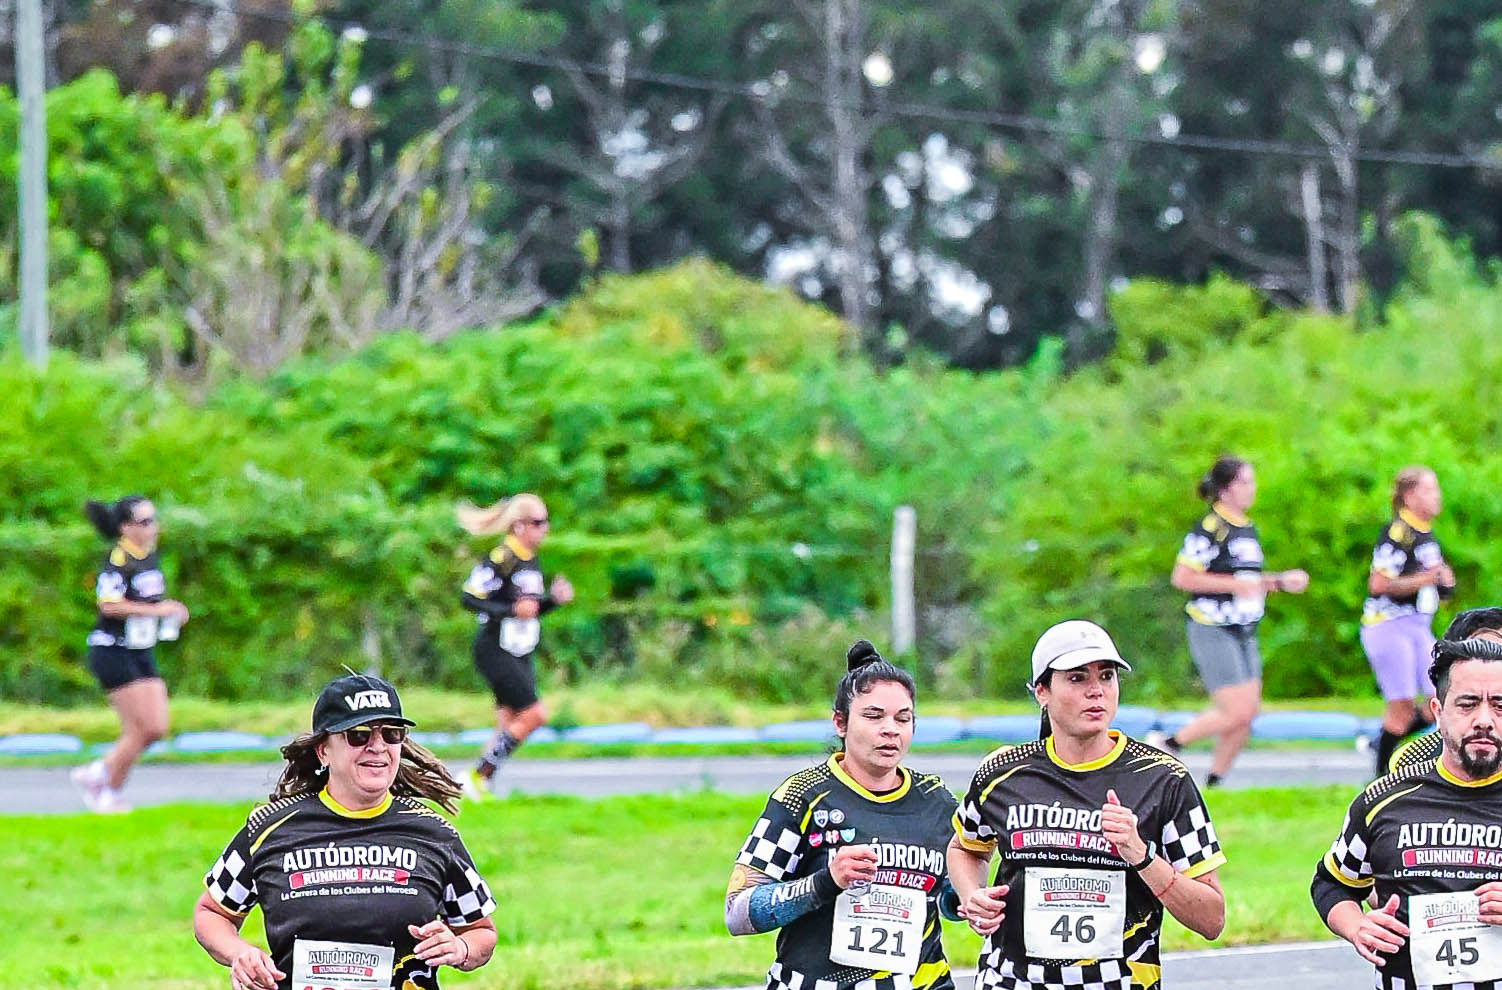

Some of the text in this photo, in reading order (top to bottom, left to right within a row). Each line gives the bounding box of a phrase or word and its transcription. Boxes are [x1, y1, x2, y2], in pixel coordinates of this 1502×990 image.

[344, 690, 392, 711] VANS
[1006, 801, 1102, 832] AUTÓDRO
[1022, 832, 1112, 853] RUNNING RACE
[282, 842, 418, 873] AUTÓDROMO
[828, 838, 944, 876] ÓDROMO
[1012, 852, 1037, 860] Carrera
[1037, 852, 1047, 860] de
[1048, 853, 1060, 861] los
[1061, 853, 1086, 862] Clubes
[1088, 855, 1100, 864] del
[1415, 850, 1474, 865] RUNNING
[302, 867, 396, 885] RUNNING RACE
[898, 872, 928, 889] RACE
[1040, 874, 1111, 893] AUTÓDROMO
[1394, 869, 1402, 878] La
[1403, 869, 1431, 877] Carrera
[1431, 869, 1443, 878] de
[1443, 869, 1456, 878] los
[1457, 870, 1484, 879] Clubes
[1485, 871, 1498, 880] del
[290, 888, 319, 899] Carrera
[319, 887, 330, 896] de
[331, 887, 343, 895] los
[344, 886, 371, 895] Clubes
[372, 885, 385, 894] del
[1423, 896, 1479, 919] AUTÓDRO
[1050, 914, 1096, 943] 46
[847, 926, 906, 957] 121
[1435, 937, 1479, 967] 45
[308, 947, 380, 967] AUTÓDROMO
